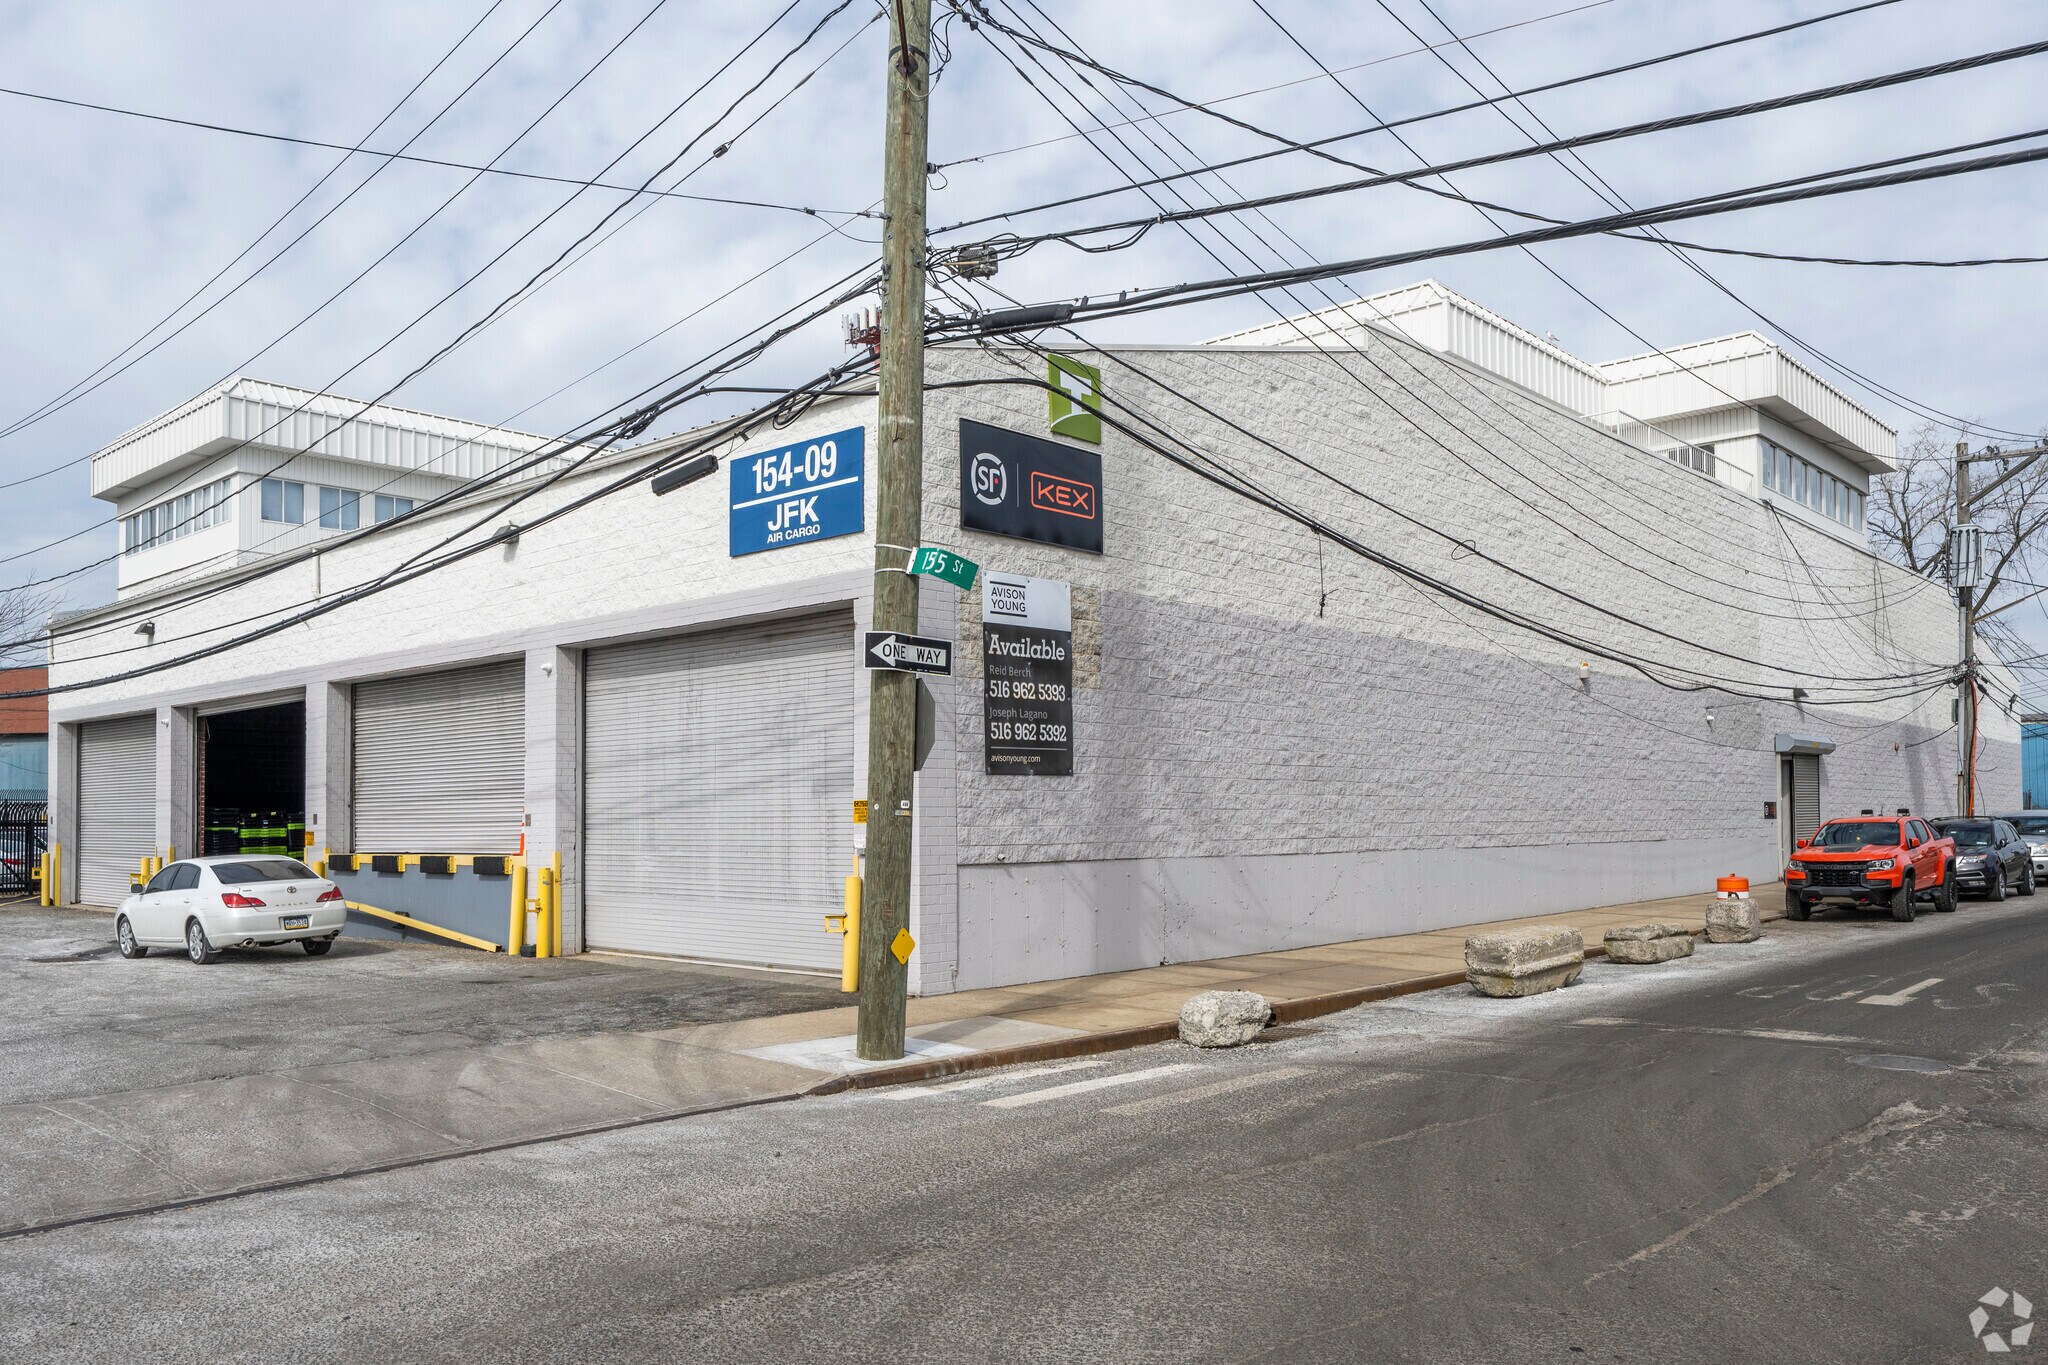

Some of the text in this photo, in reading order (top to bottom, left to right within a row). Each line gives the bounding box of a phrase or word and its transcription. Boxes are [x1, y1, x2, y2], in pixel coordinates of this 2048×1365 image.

[752, 440, 838, 495] 154-09
[1037, 481, 1089, 511] KEX
[767, 495, 820, 532] JFK
[766, 524, 821, 544] AIR CARGO
[921, 551, 964, 575] 155 St
[991, 586, 1026, 601] AVISON
[991, 598, 1026, 613] YOUNG
[882, 643, 942, 664] ONE WAY
[988, 633, 1066, 661] Available
[989, 664, 1032, 678] Reid Berch
[989, 679, 1066, 702] 516 962 5393
[989, 706, 1048, 722] Joseph Lagano
[990, 721, 1067, 742] 516 962 5392
[990, 753, 1041, 765] avisonyoung.com
